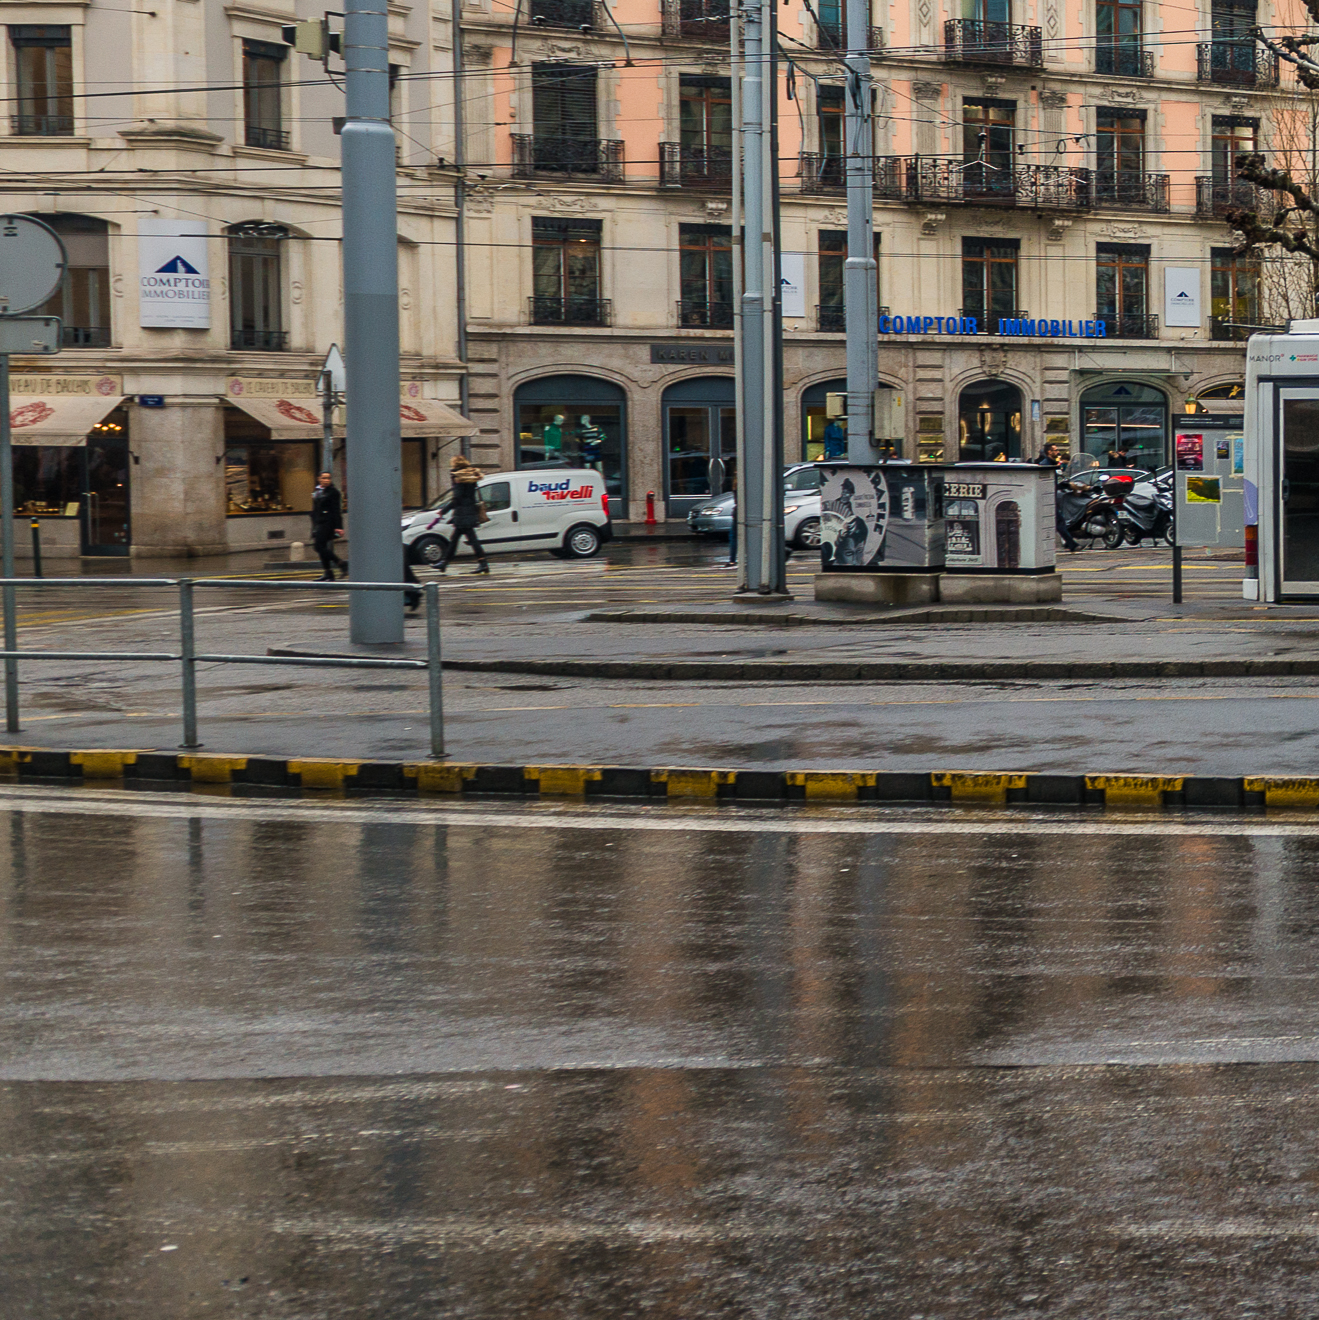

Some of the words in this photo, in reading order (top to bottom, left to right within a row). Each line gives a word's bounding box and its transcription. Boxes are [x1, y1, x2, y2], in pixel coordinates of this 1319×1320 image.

[879, 315, 977, 335] COMPTOIR
[999, 318, 1107, 338] IMMOBILIER
[657, 349, 708, 361] KAREN
[1249, 354, 1281, 362] MANOR
[527, 479, 571, 492] baud
